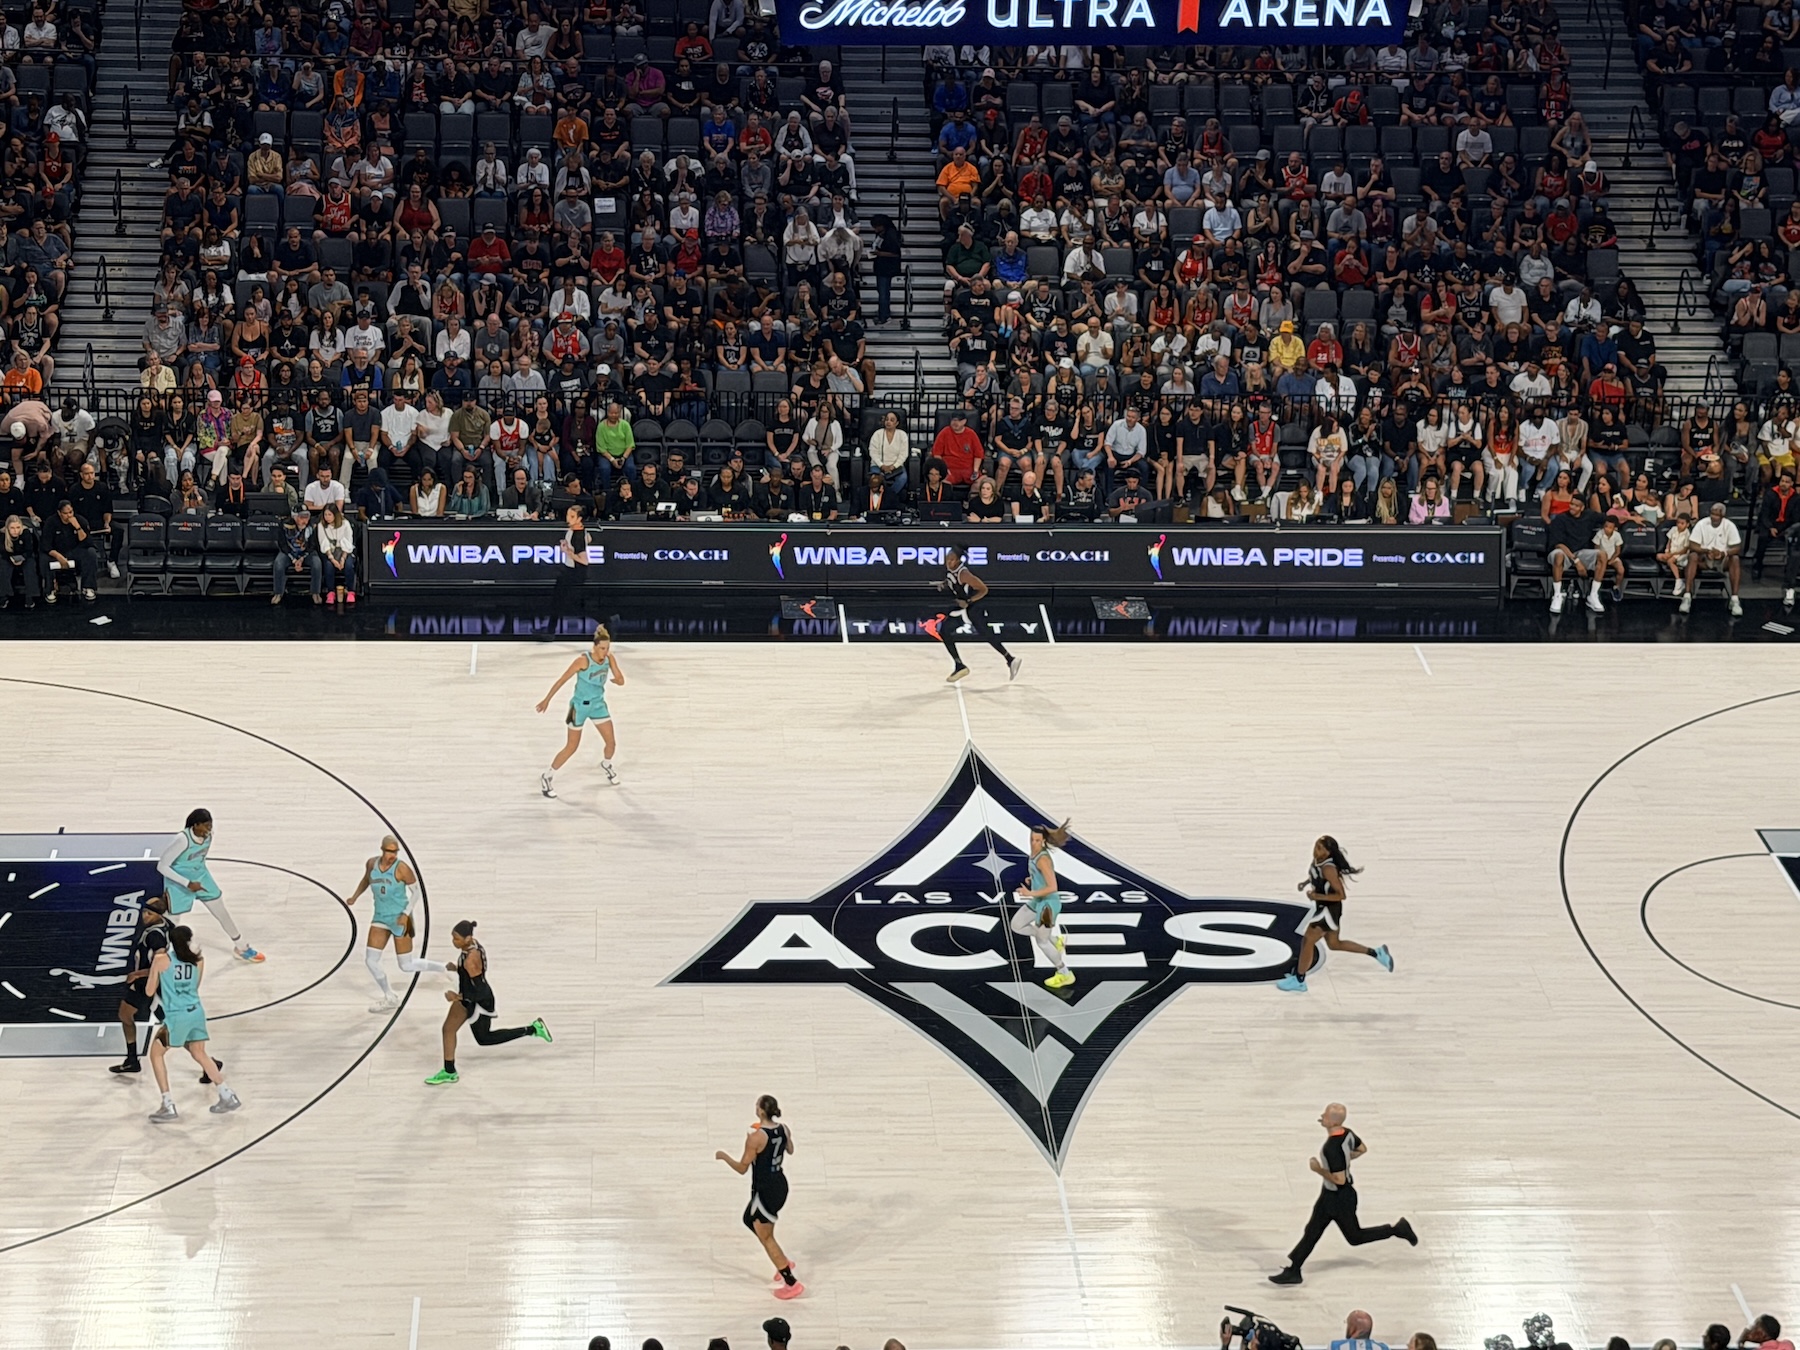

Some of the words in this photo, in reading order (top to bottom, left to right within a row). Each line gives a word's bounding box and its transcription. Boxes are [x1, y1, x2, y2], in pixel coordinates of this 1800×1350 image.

[799, 0, 966, 29] Michelob
[987, 0, 1156, 28] ULTRA
[1218, 0, 1392, 27] ARENA
[320, 424, 332, 433] 22
[1644, 458, 1655, 472] E
[407, 545, 507, 564] WNBA
[512, 545, 605, 564] PRIE
[613, 551, 641, 561] Presented
[642, 552, 648, 562] by
[653, 549, 729, 561] COACH
[793, 546, 890, 565] WNBA
[897, 546, 988, 565] PRIE
[997, 552, 1021, 562] Presented
[1022, 553, 1030, 563] by
[1036, 550, 1110, 562] COACH
[1171, 547, 1267, 566] WNBA
[1273, 548, 1364, 567] PRIDE
[1372, 554, 1399, 563] Presented
[1399, 554, 1406, 564] by
[1411, 552, 1485, 564] COACH
[854, 891, 952, 905] LAS
[977, 891, 1148, 905] VEGAS
[95, 889, 146, 972] WNBA
[721, 912, 1292, 971] ACES
[174, 964, 193, 981] 30
[771, 1136, 783, 1158] 7
